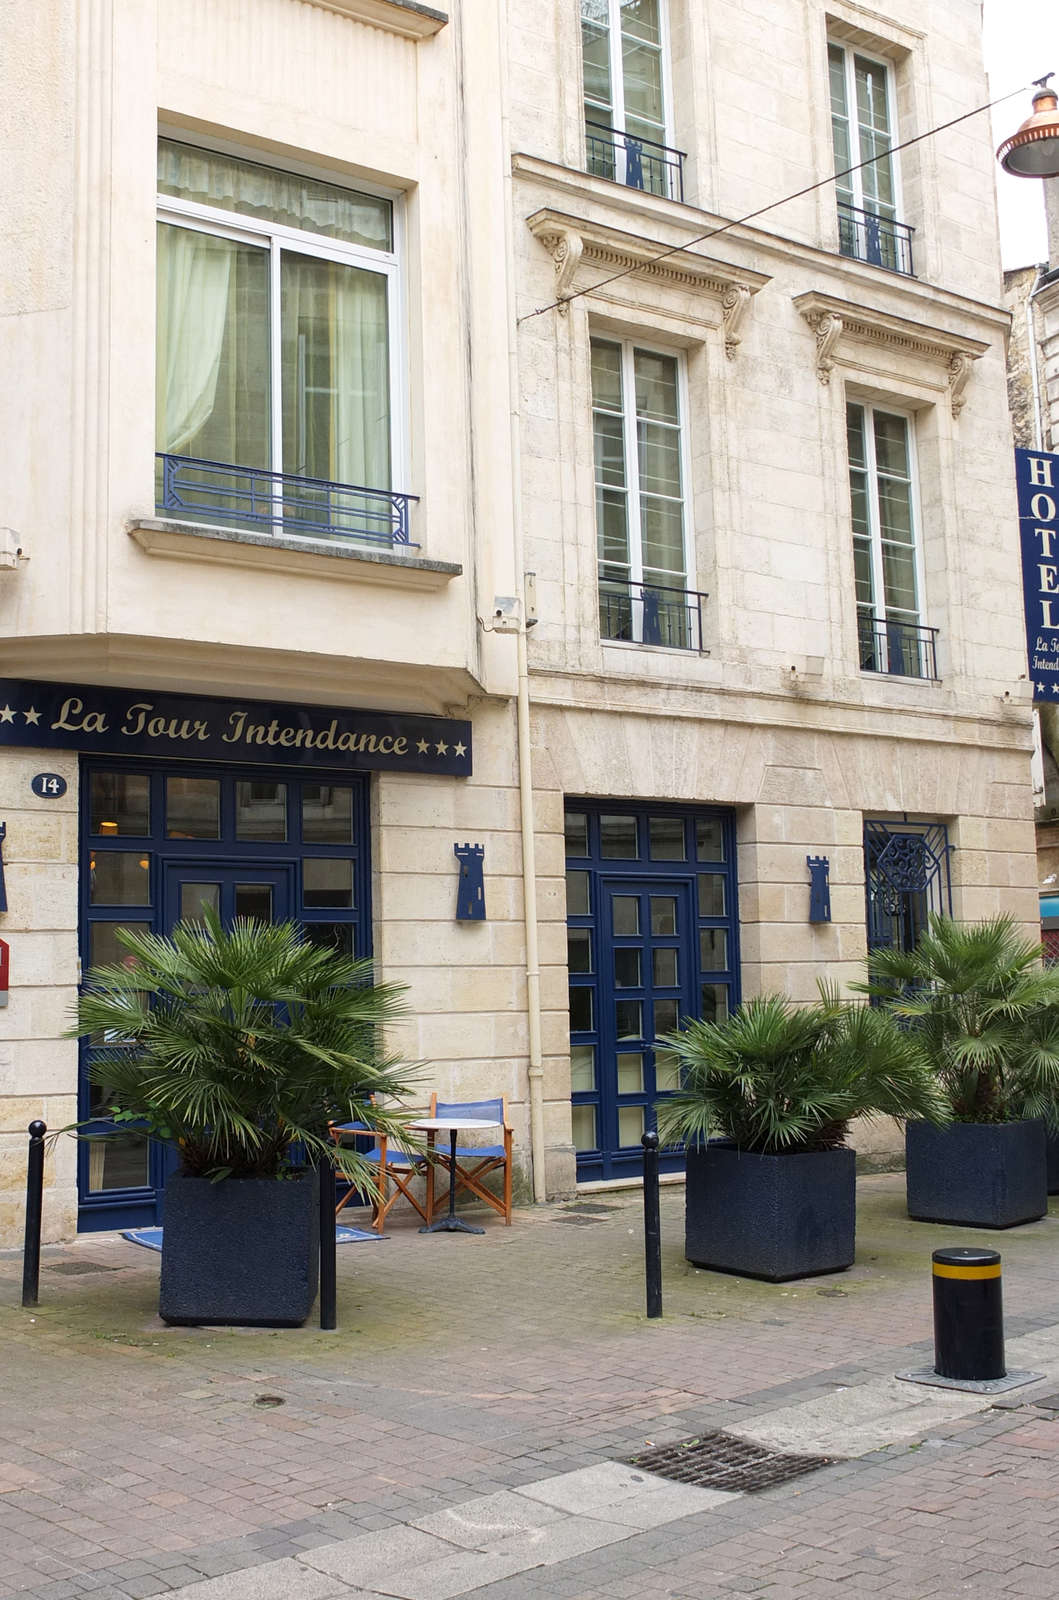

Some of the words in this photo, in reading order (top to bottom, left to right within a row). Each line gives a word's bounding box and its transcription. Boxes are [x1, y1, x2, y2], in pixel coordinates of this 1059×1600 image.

[1027, 456, 1059, 629] HOTEL
[1035, 636, 1048, 652] La
[51, 697, 109, 733] La
[121, 703, 210, 741] Tour
[222, 711, 409, 756] Intendance
[41, 777, 60, 794] 14
